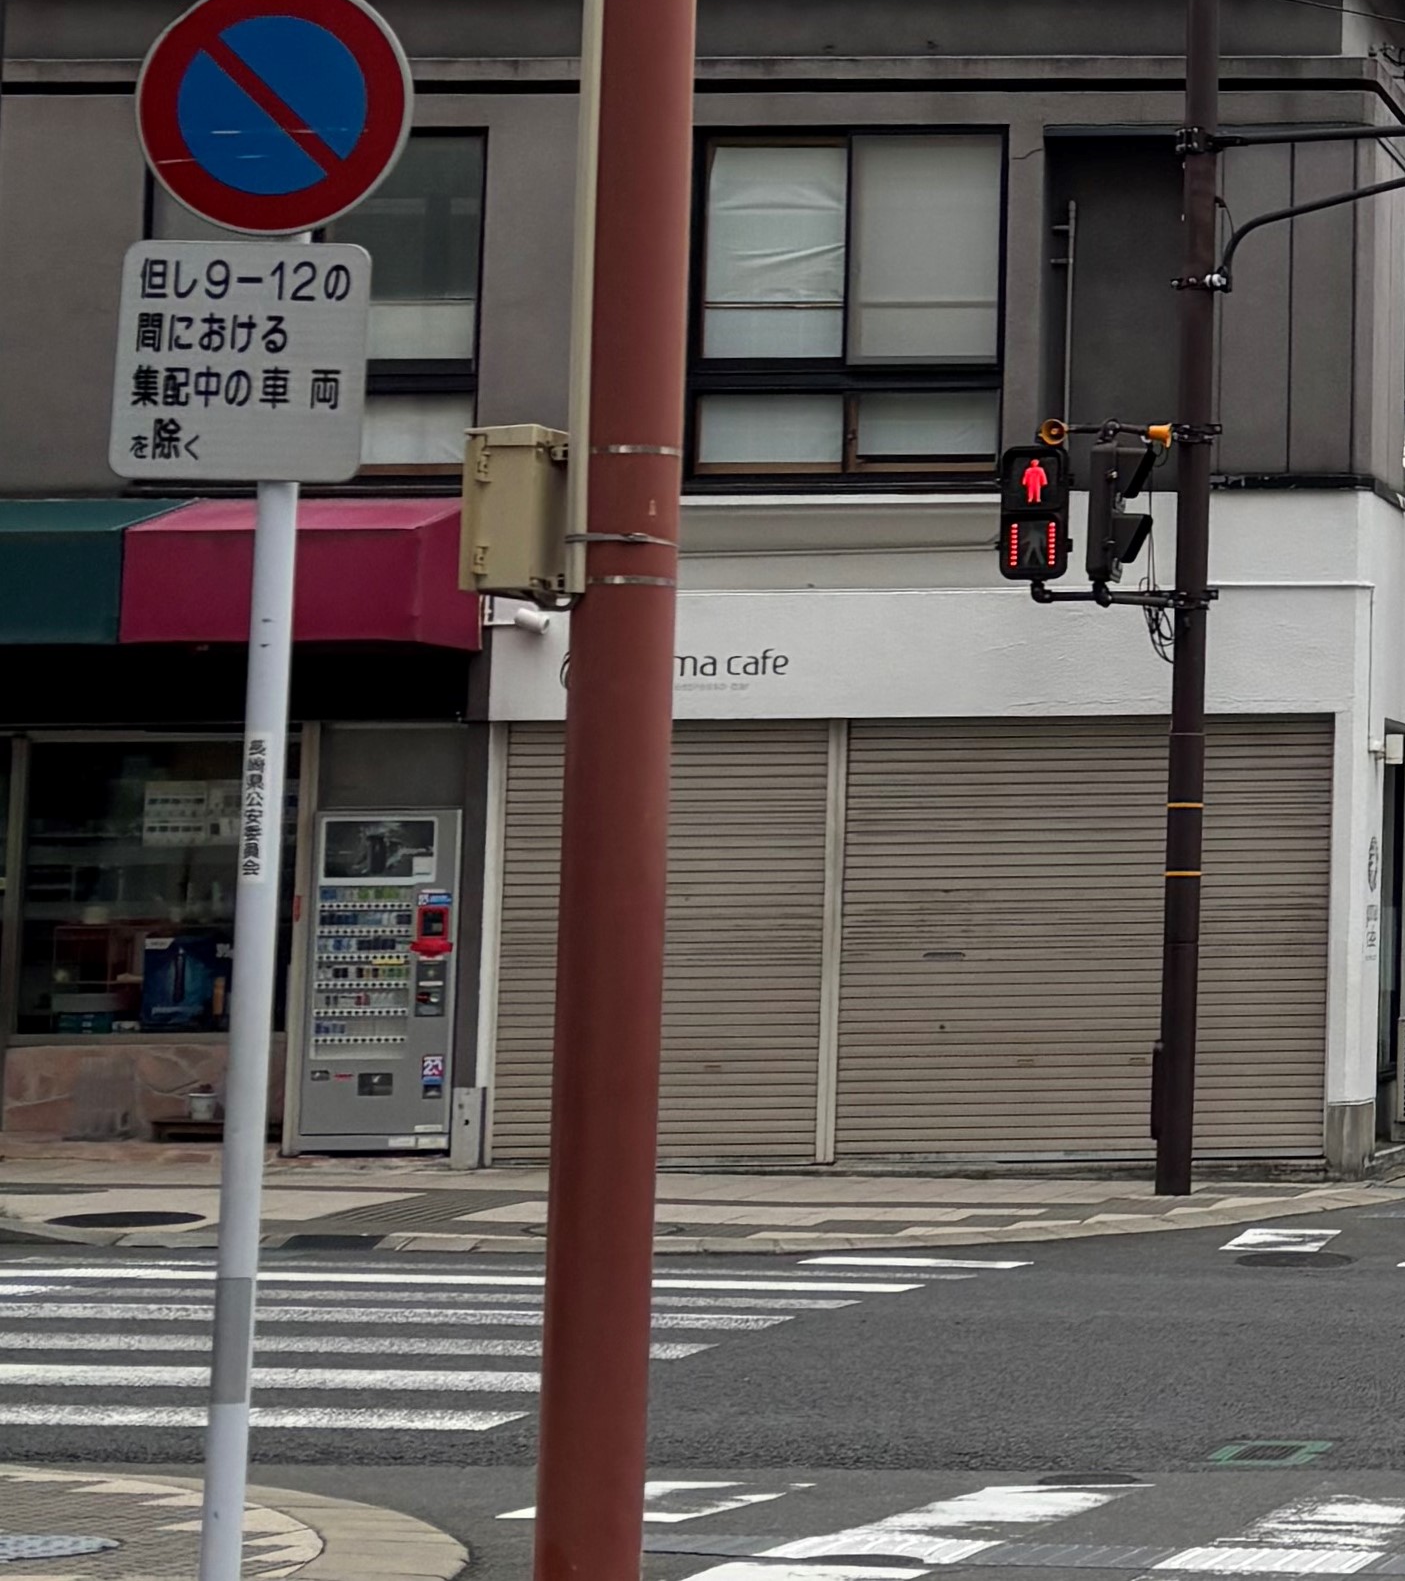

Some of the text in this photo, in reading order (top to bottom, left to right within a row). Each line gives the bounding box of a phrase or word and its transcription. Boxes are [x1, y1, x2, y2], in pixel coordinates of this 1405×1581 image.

[136, 312, 288, 354] 間における
[130, 364, 342, 410] 集配中の車両
[129, 418, 200, 461] を除く
[726, 648, 789, 676] cafe
